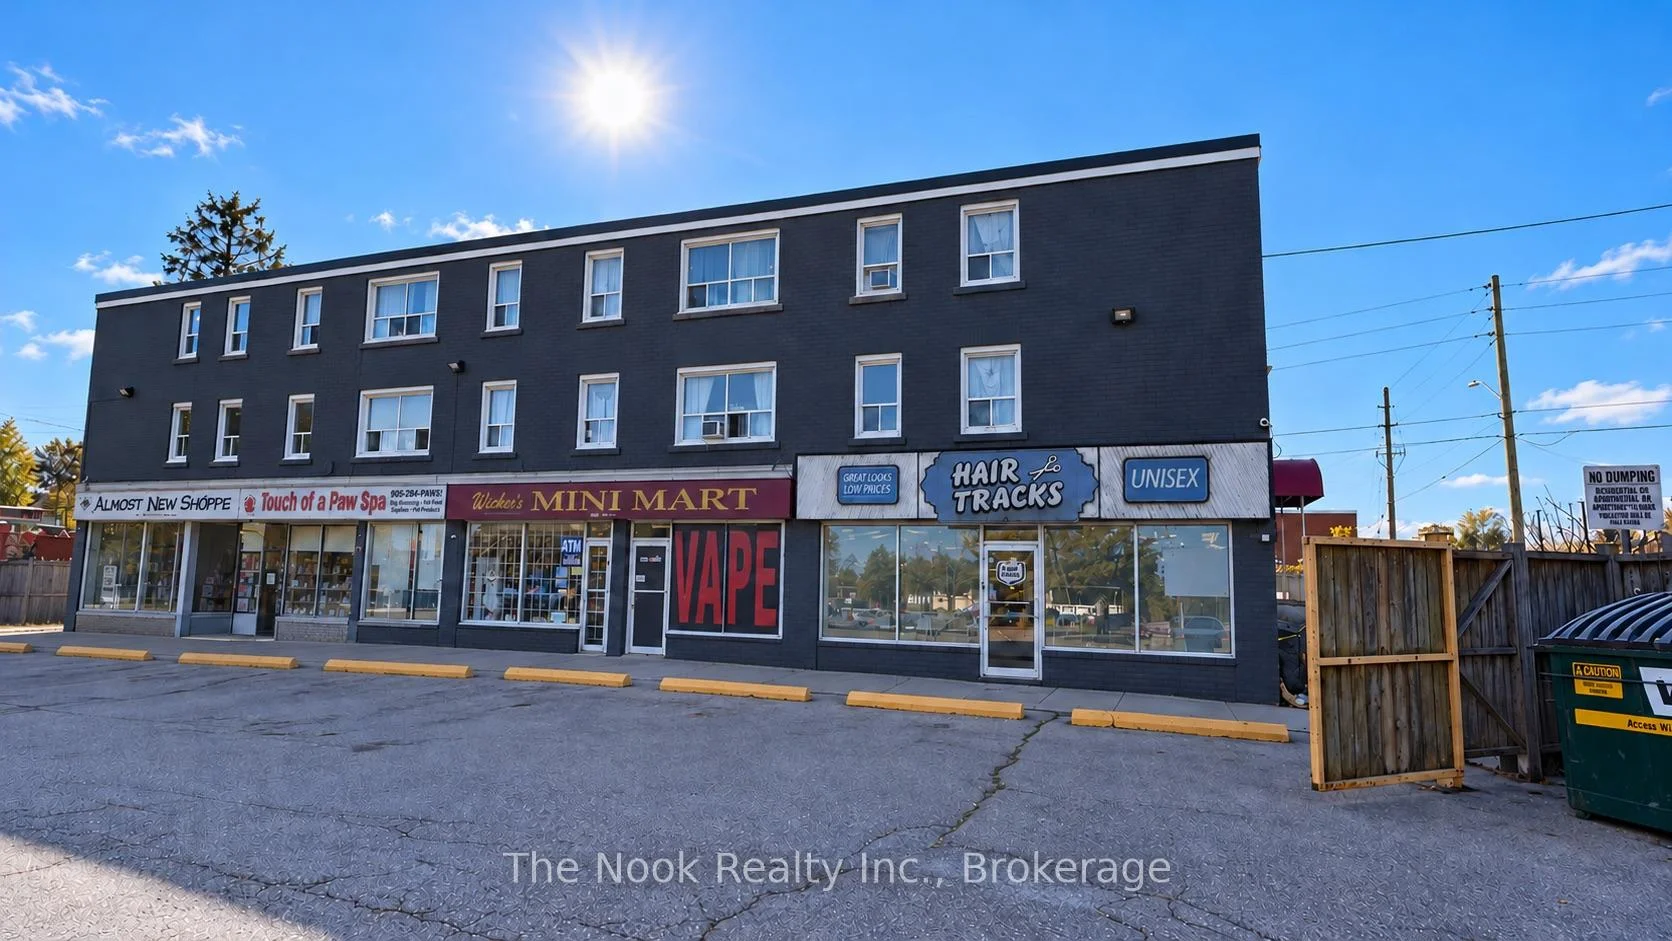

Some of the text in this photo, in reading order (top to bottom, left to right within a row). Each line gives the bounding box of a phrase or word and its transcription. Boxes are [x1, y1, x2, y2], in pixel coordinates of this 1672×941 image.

[843, 472, 892, 482] GREAT LOOKS
[952, 458, 1020, 487] HAIR
[1131, 468, 1200, 489] UNISEX
[1588, 470, 1656, 483] NO DUMPING
[843, 484, 891, 495] LOW PRICES
[954, 481, 1064, 514] TRACKS
[92, 496, 144, 513] ALMOST
[147, 496, 178, 512] NEW
[261, 490, 387, 516] Touch of a Paw Spa
[530, 487, 758, 511] MINI MART
[561, 539, 581, 553] ATM
[674, 530, 779, 626] VAPE
[1583, 665, 1619, 677] CAUTION
[1627, 719, 1657, 730] Access
